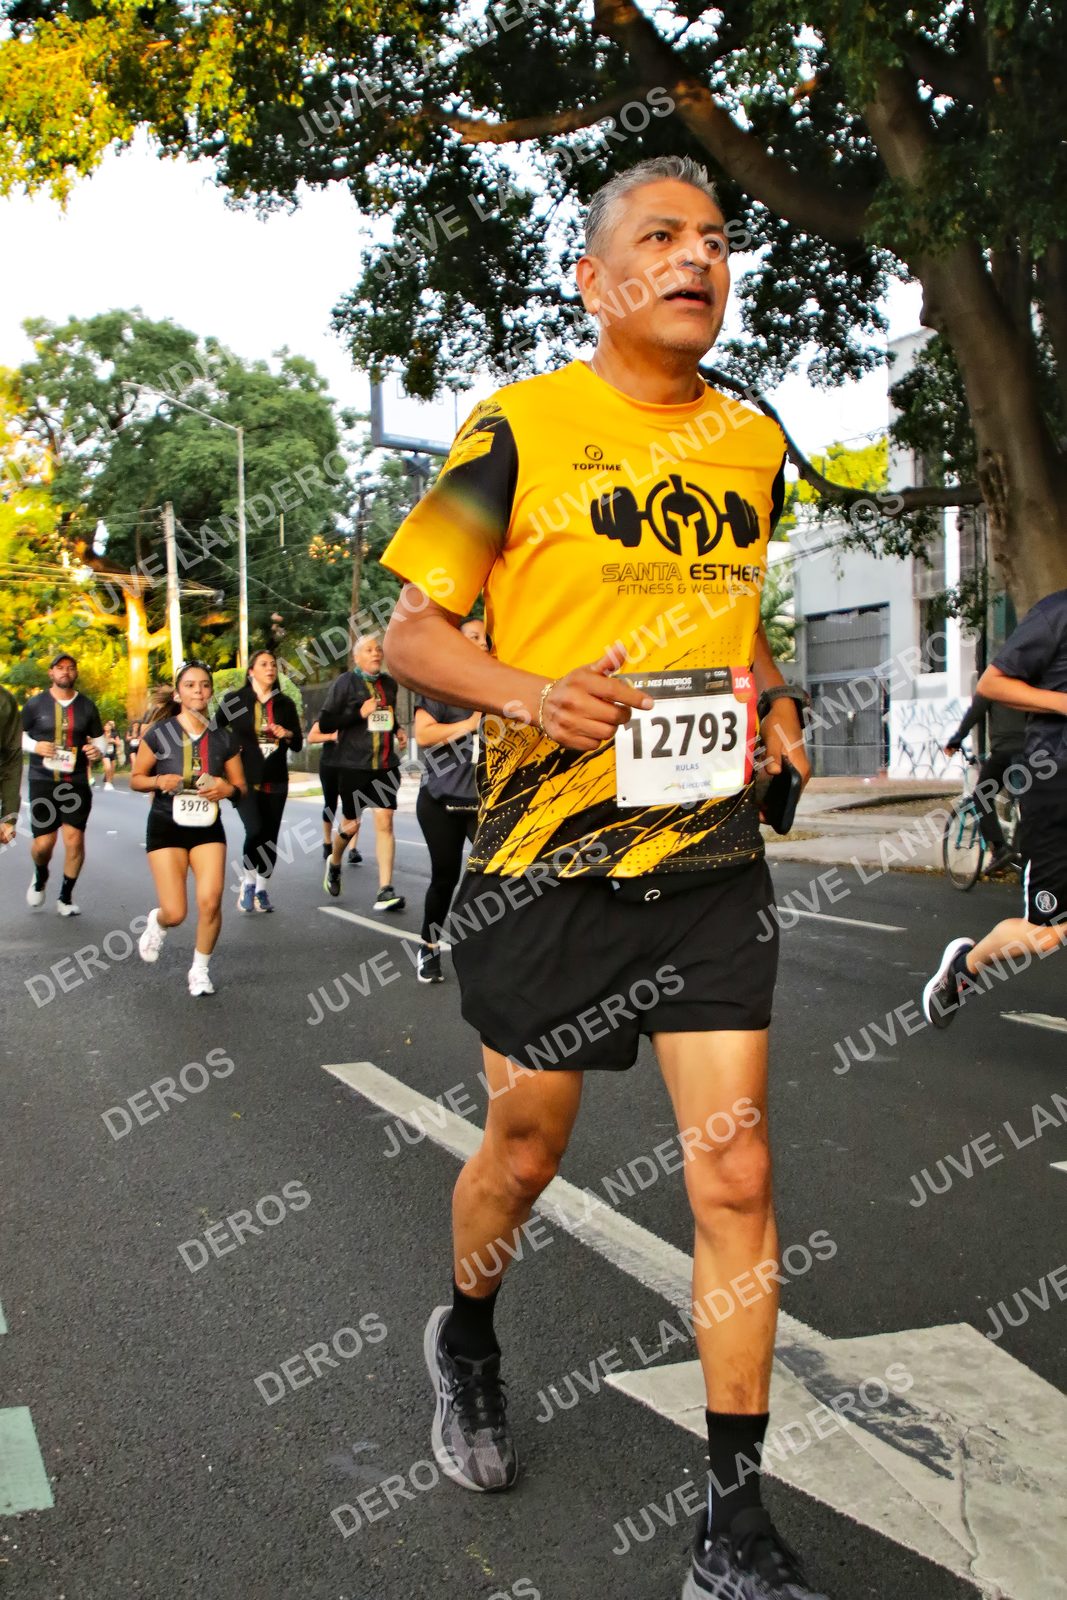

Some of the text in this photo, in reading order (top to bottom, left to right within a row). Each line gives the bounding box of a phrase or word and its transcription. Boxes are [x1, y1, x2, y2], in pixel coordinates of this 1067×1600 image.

[572, 463, 622, 471] TOPTIME
[602, 562, 760, 583] SANTA ESTHER
[617, 583, 673, 595] FITNESS
[677, 583, 687, 594] &
[735, 677, 751, 689] 10K
[372, 714, 389, 722] 2382
[624, 710, 738, 760] 12793
[675, 763, 699, 772] RULAS
[180, 800, 209, 812] 3978
